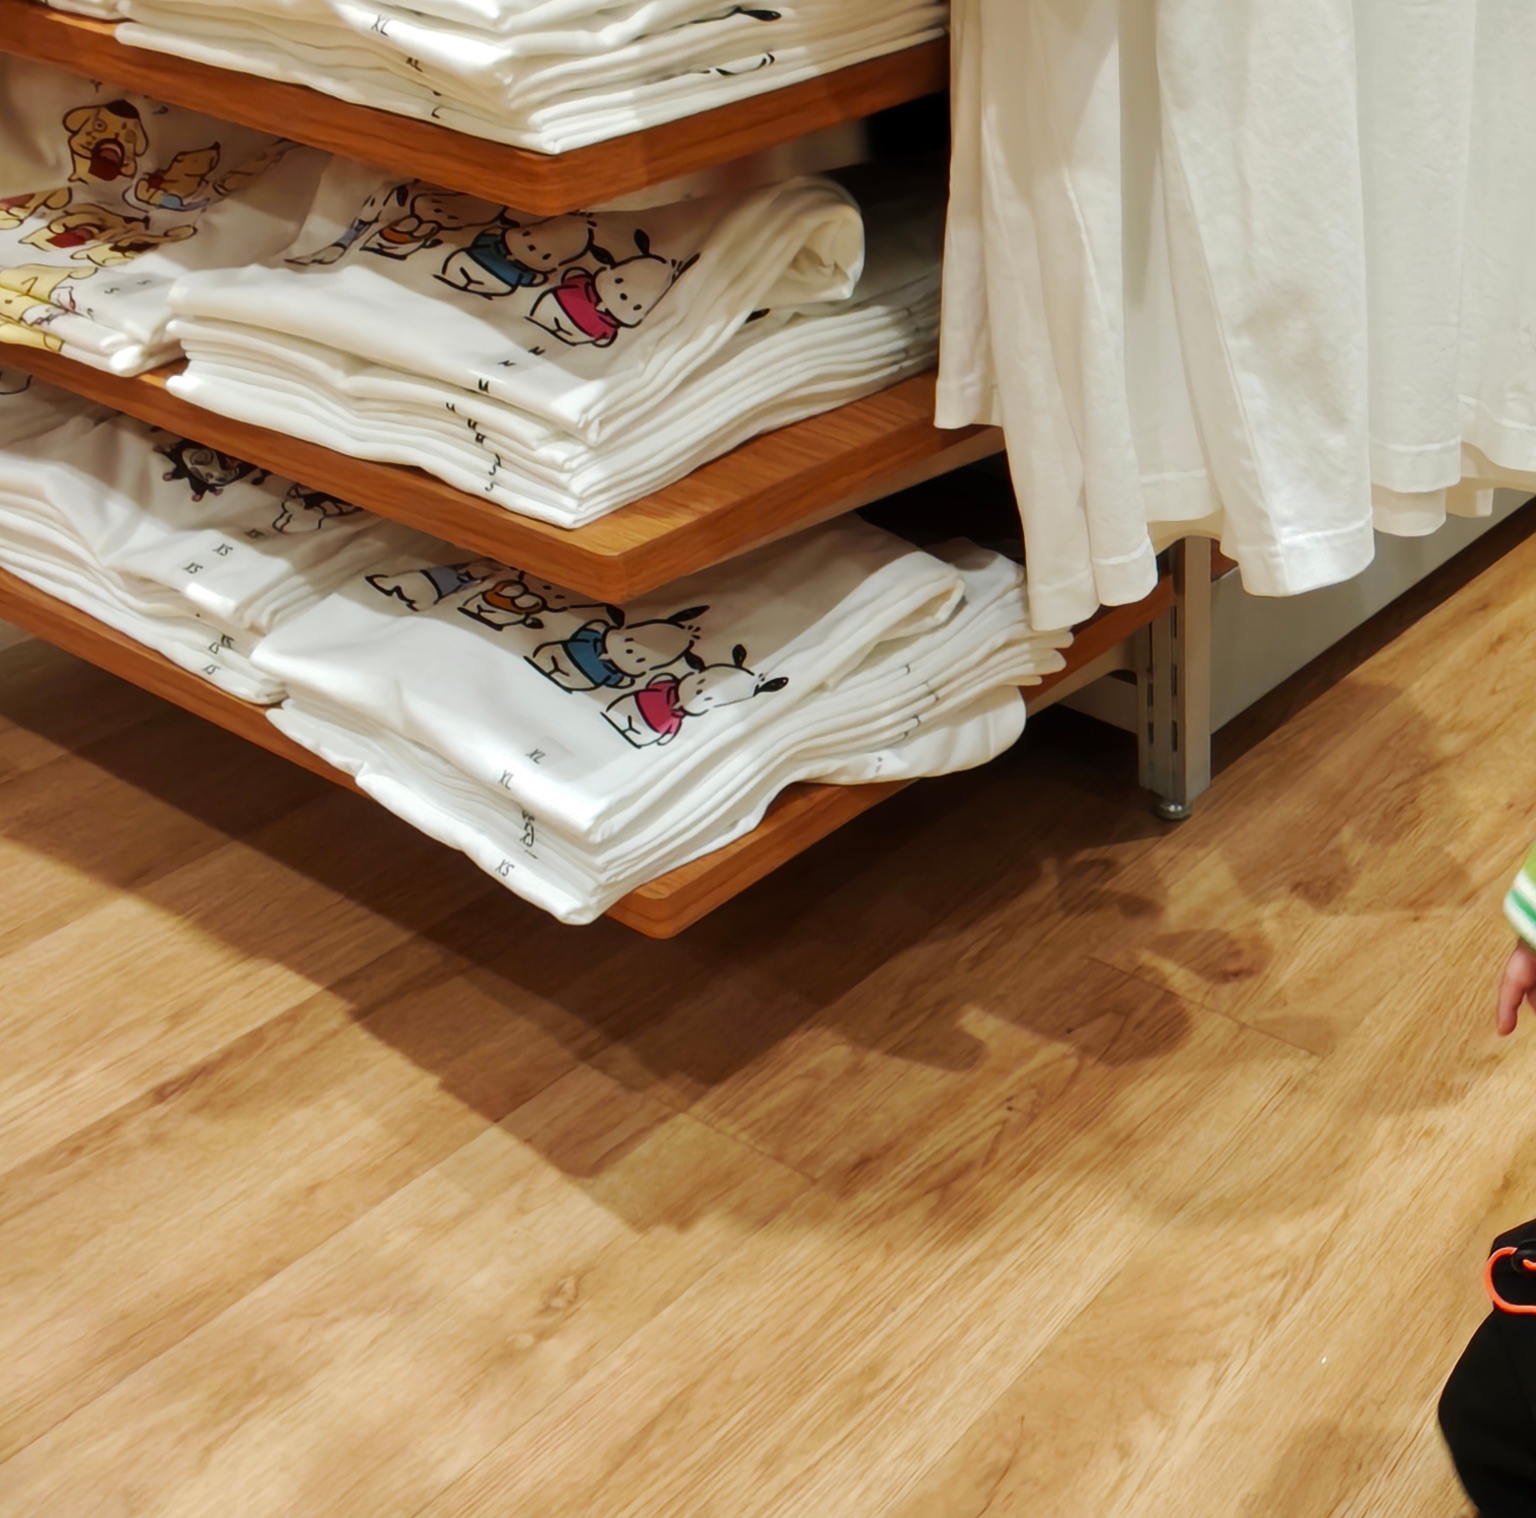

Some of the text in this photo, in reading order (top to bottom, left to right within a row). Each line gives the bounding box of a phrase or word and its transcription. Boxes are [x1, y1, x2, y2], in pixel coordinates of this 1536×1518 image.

[370, 14, 389, 37] XL
[212, 543, 233, 557] XS
[183, 562, 204, 575] XS
[525, 747, 547, 765] XL
[498, 769, 514, 791] XL
[494, 859, 515, 877] XS
